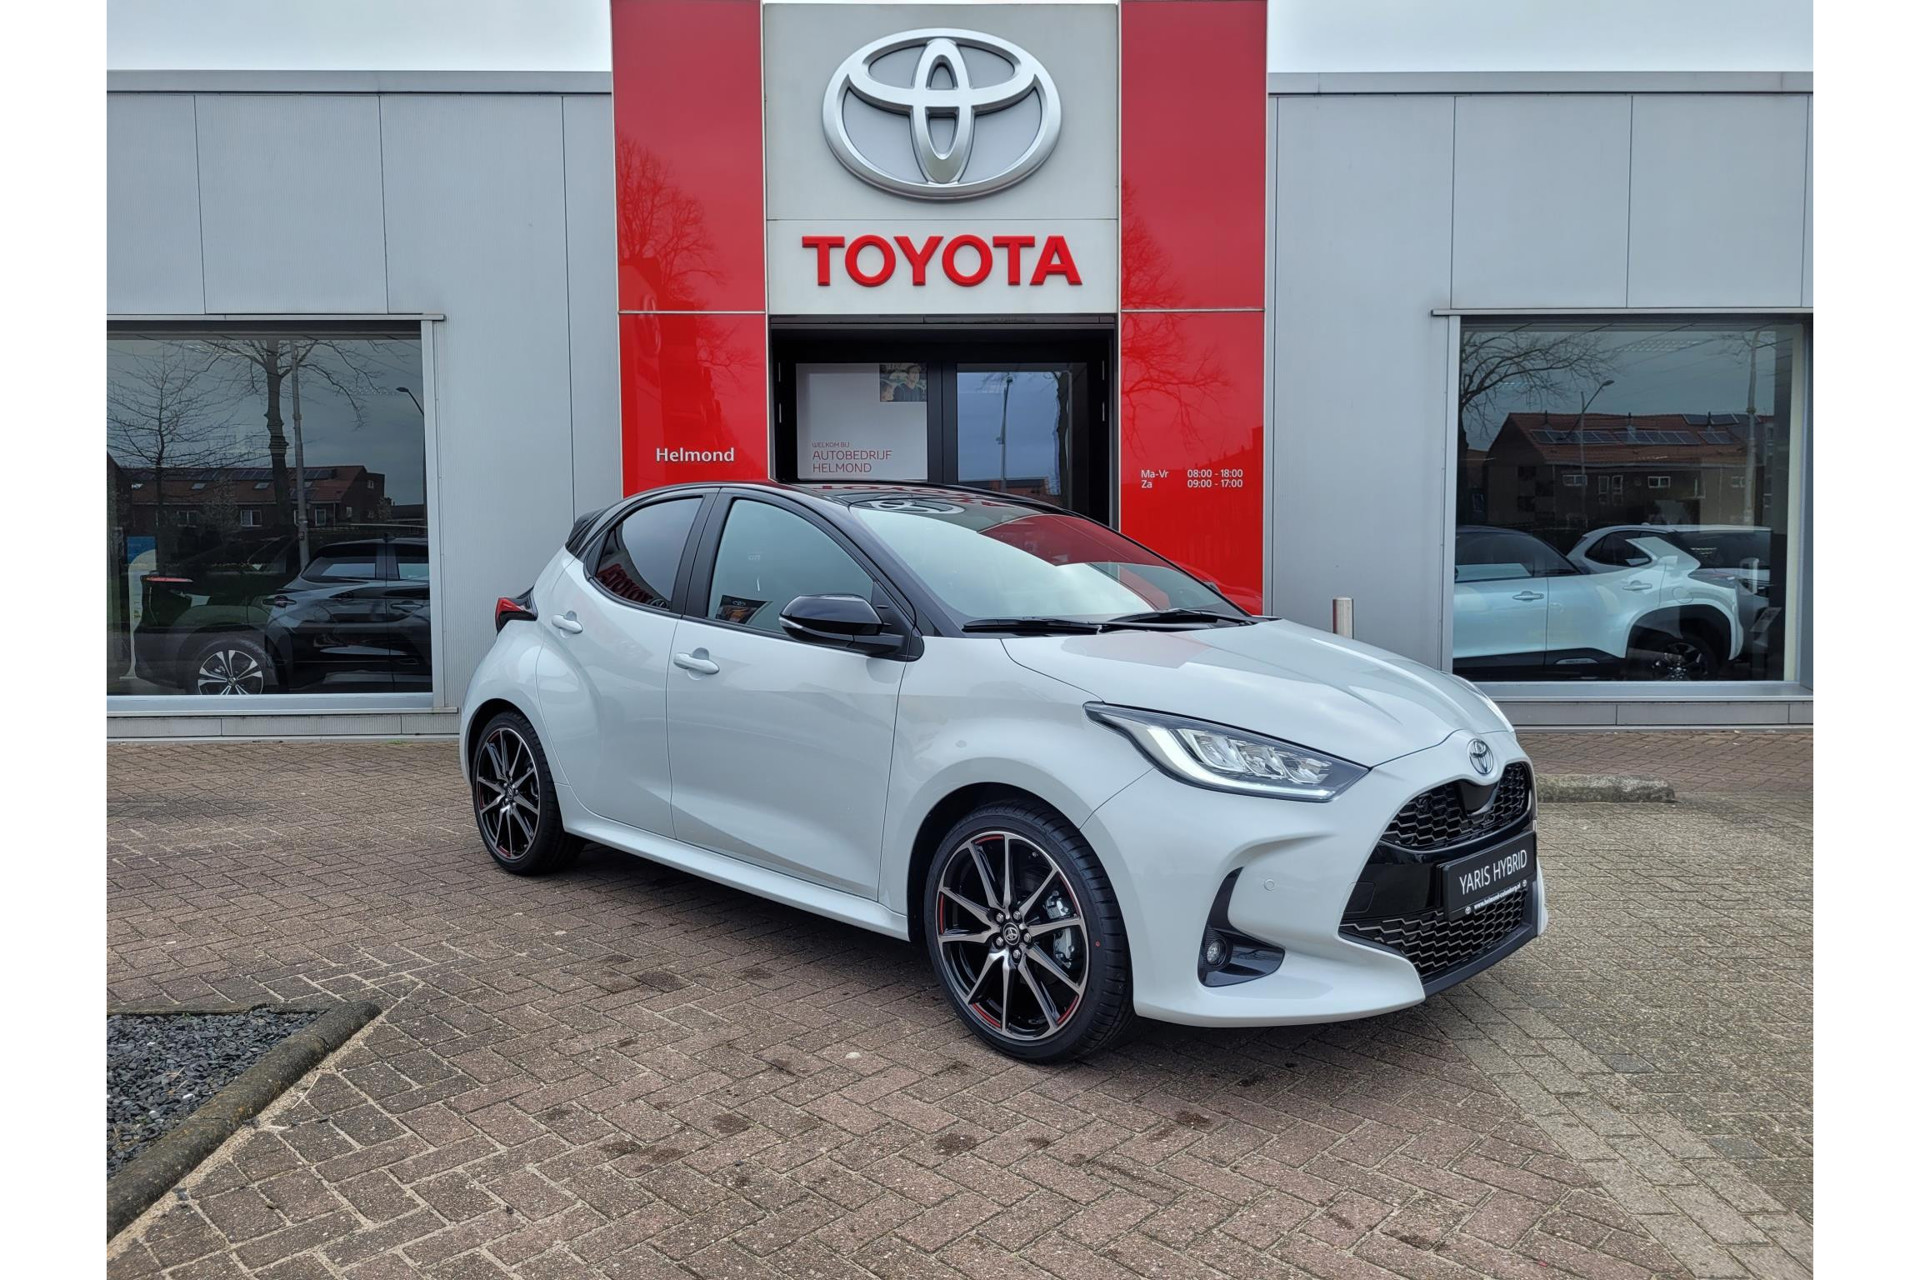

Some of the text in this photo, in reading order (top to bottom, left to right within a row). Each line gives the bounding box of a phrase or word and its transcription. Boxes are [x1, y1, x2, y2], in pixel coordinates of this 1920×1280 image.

[802, 234, 1083, 287] TOYOTA
[656, 447, 735, 462] Helmond
[812, 450, 893, 461] AUTOBEDRIJF
[812, 462, 872, 473] HELMOND
[1141, 469, 1169, 479] Ma-Vr
[1187, 469, 1212, 478] 08:00
[1220, 469, 1243, 478] 18:00
[1141, 480, 1153, 489] Za
[1187, 479, 1212, 488] 09:00
[1220, 479, 1243, 488] 17:00
[1459, 849, 1528, 895] YARIS HYBRID
